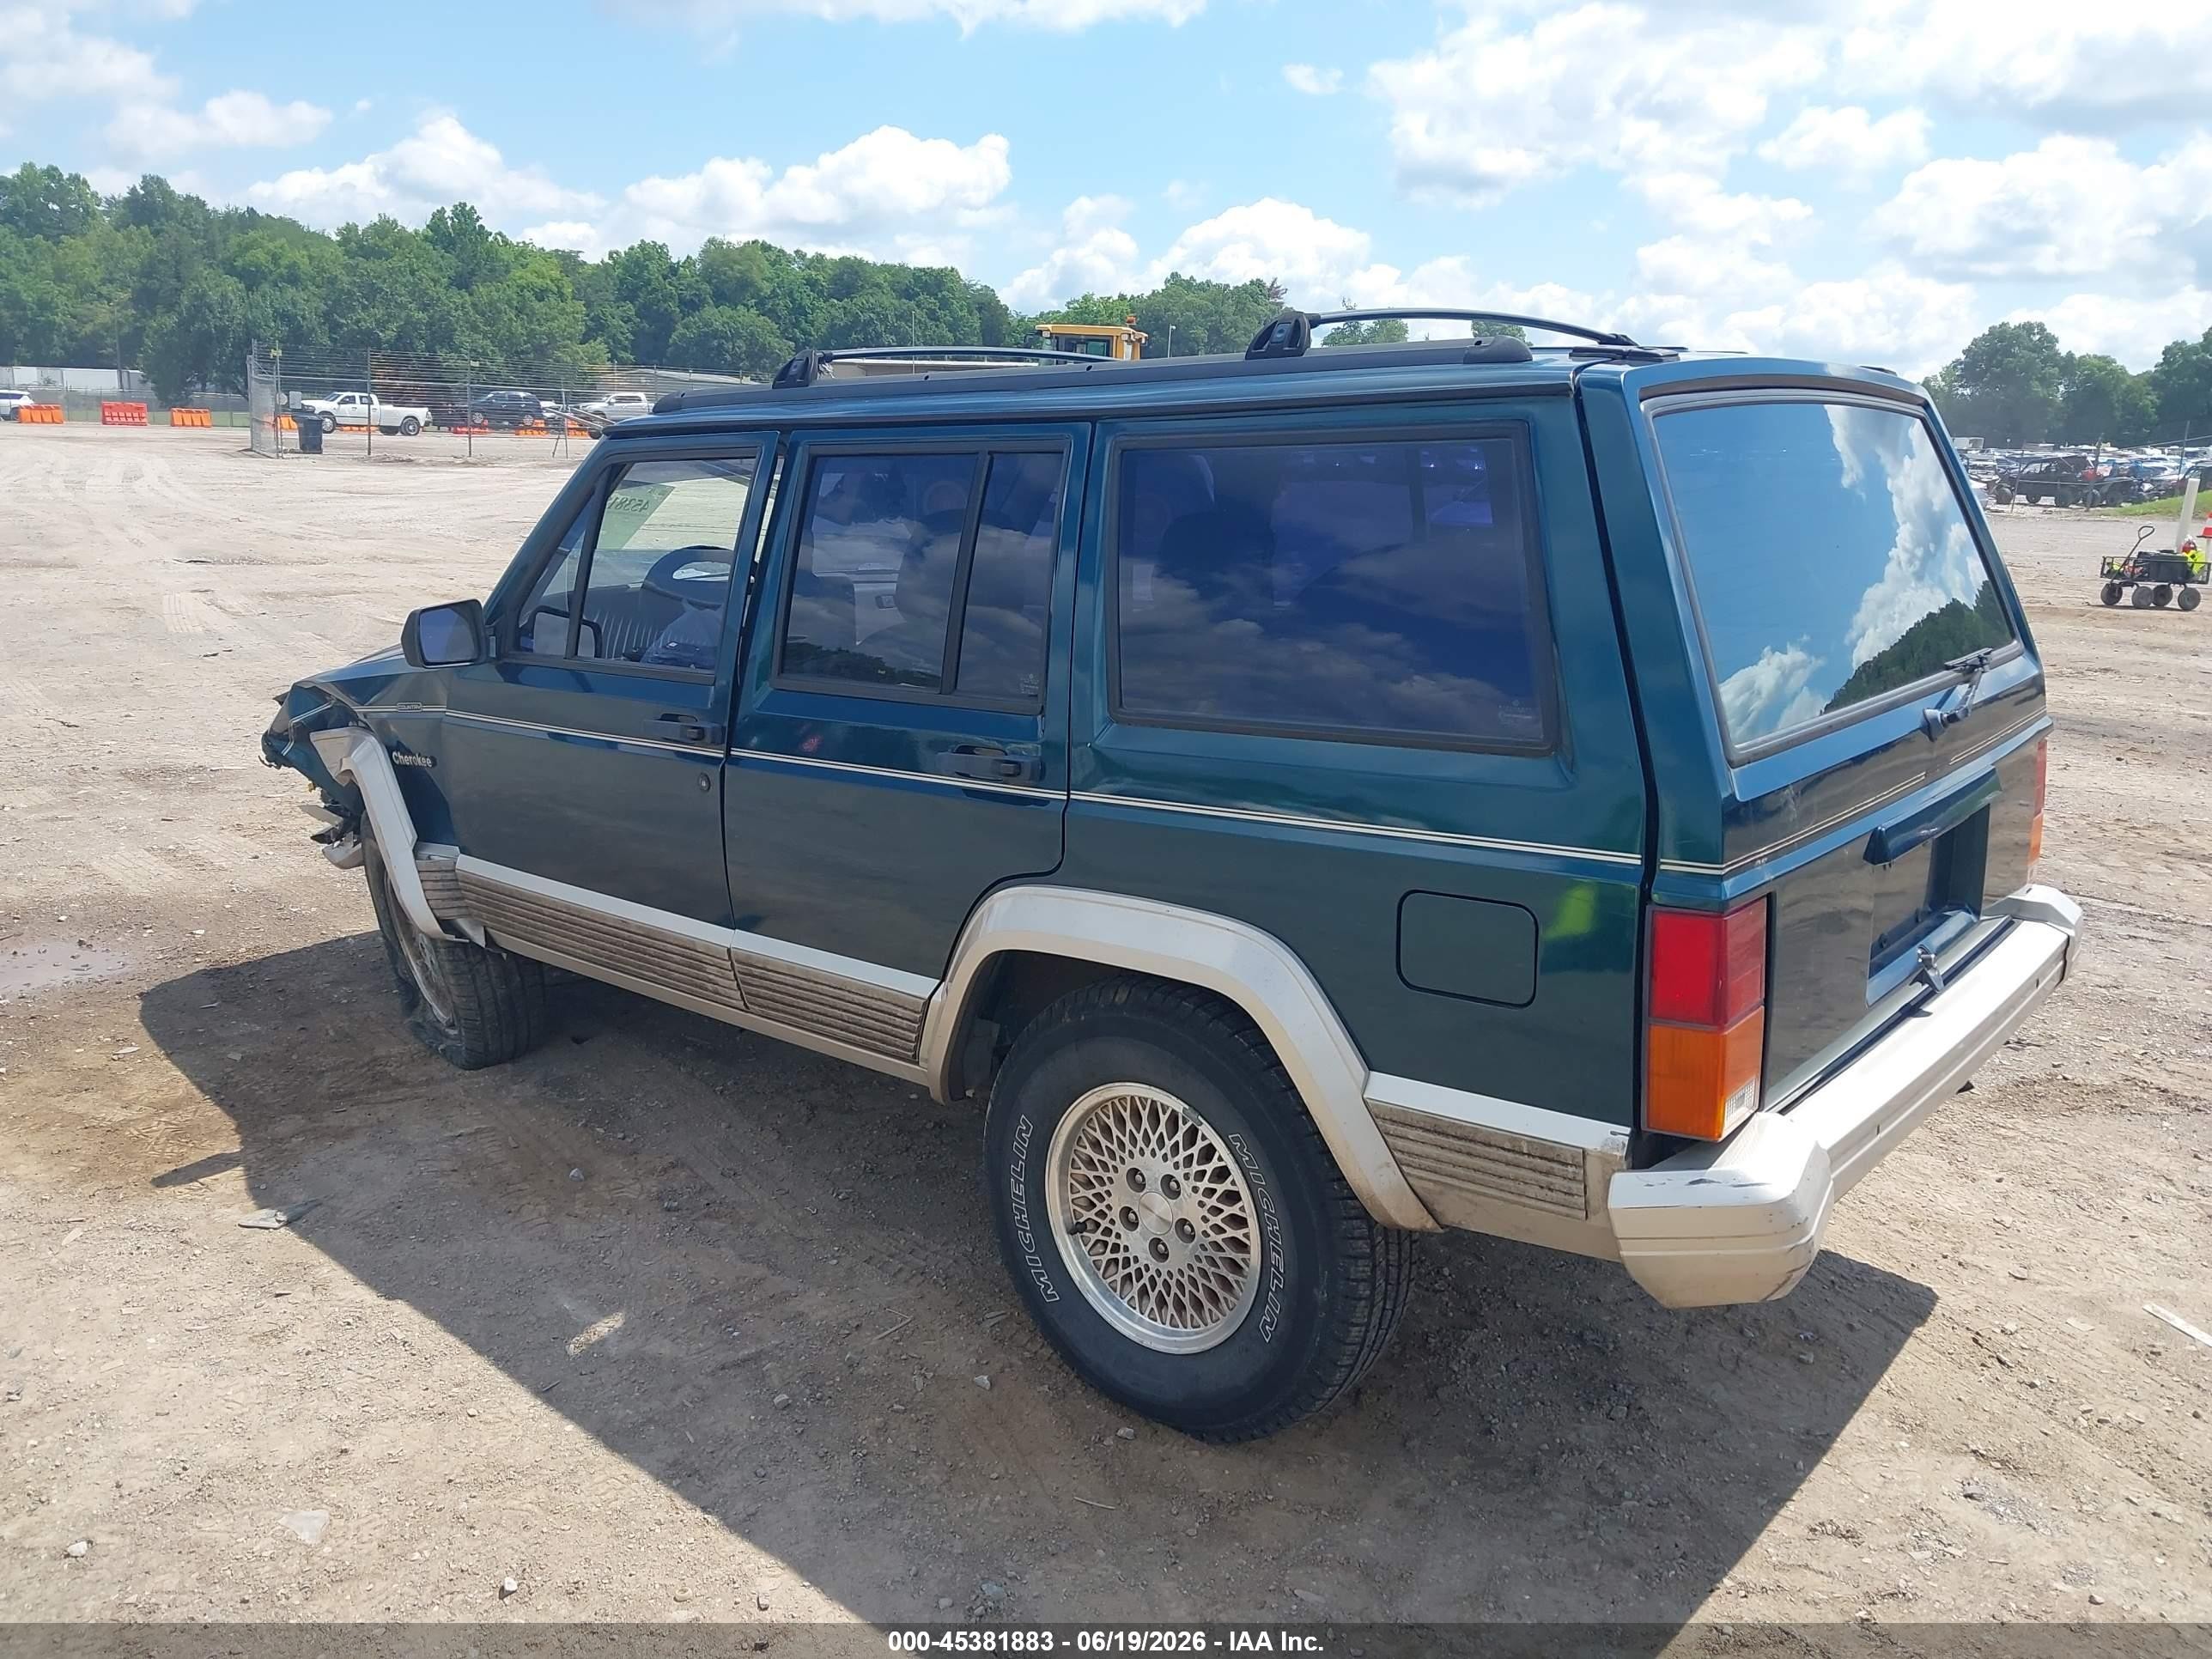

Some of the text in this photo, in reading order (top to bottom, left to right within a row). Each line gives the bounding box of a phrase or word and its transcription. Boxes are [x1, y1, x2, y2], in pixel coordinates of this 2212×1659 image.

[392, 751, 433, 768] Cherokee
[1011, 1115, 1060, 1303] MICHELIN
[1228, 1133, 1285, 1344] MICHELIN
